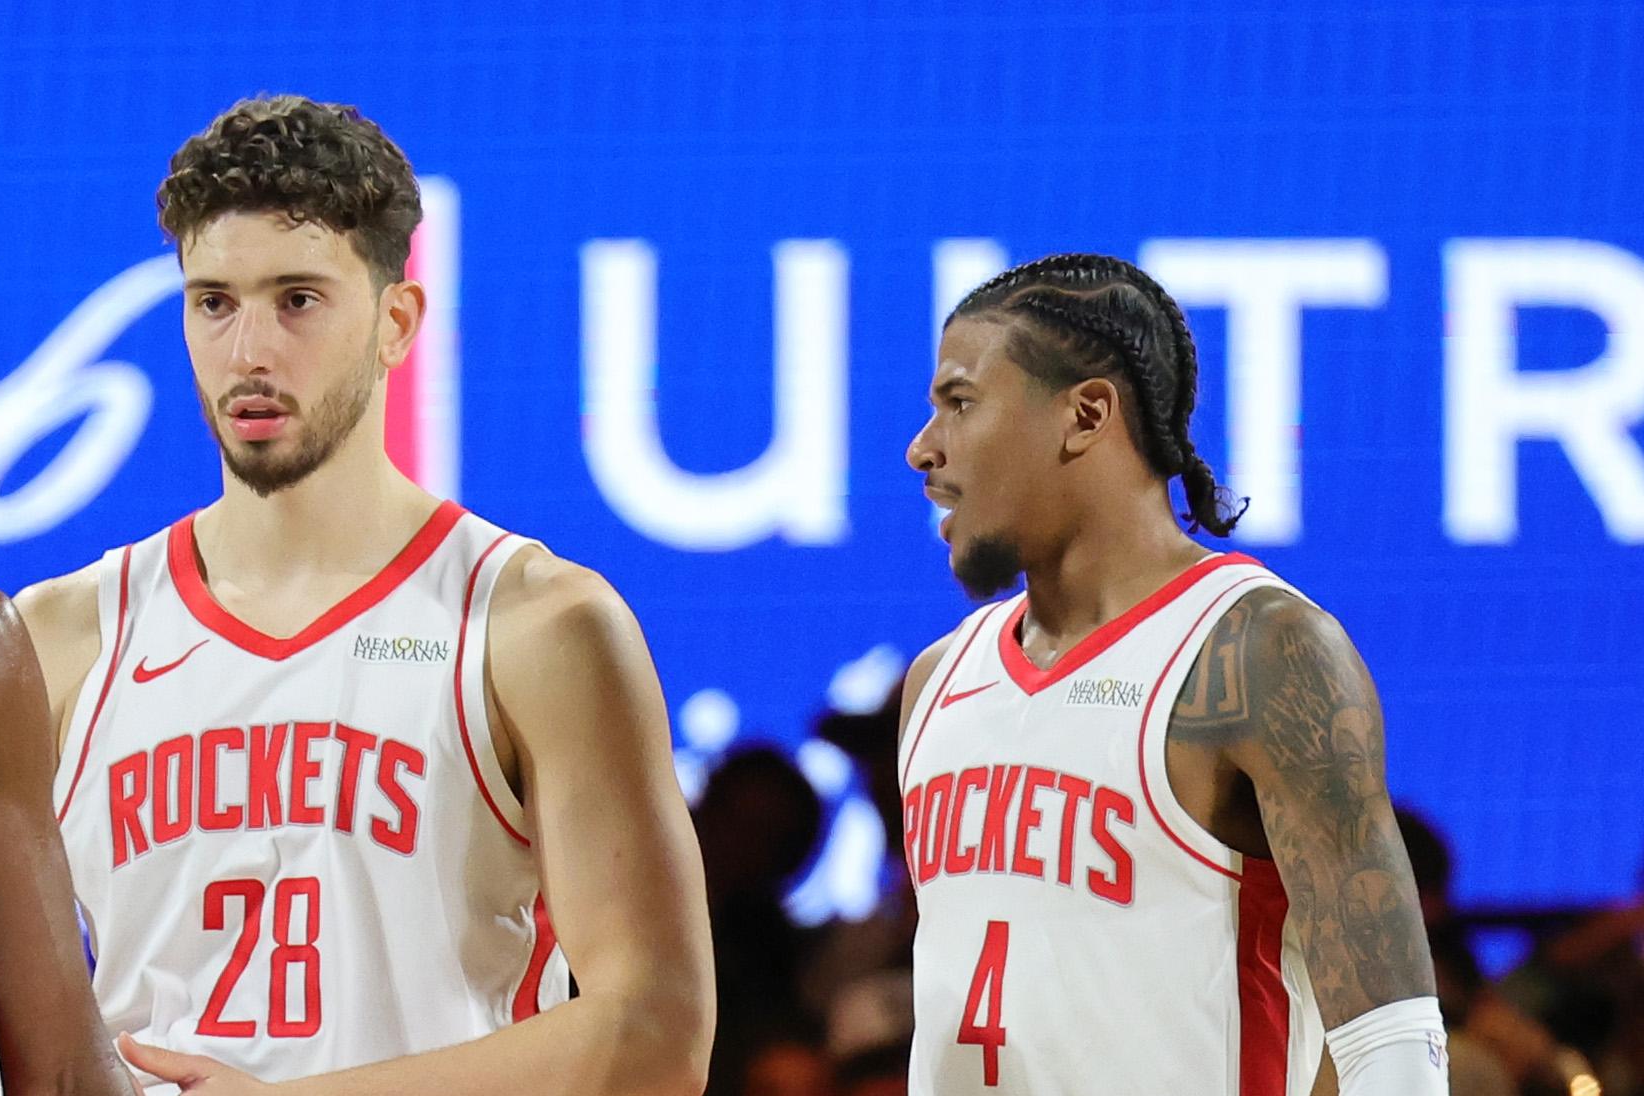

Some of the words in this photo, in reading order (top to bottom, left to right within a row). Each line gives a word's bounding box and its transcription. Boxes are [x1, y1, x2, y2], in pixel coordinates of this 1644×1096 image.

[578, 236, 1644, 552] UTR
[353, 646, 449, 661] HERMANN
[355, 633, 451, 652] MEMORIAL
[1066, 689, 1143, 707] HERMANN
[1070, 678, 1144, 697] MEMORIAL
[108, 719, 427, 871] ROCKETS
[903, 763, 1137, 908] ROCKETS
[194, 876, 323, 1039] 28
[956, 920, 1010, 1087] 4
